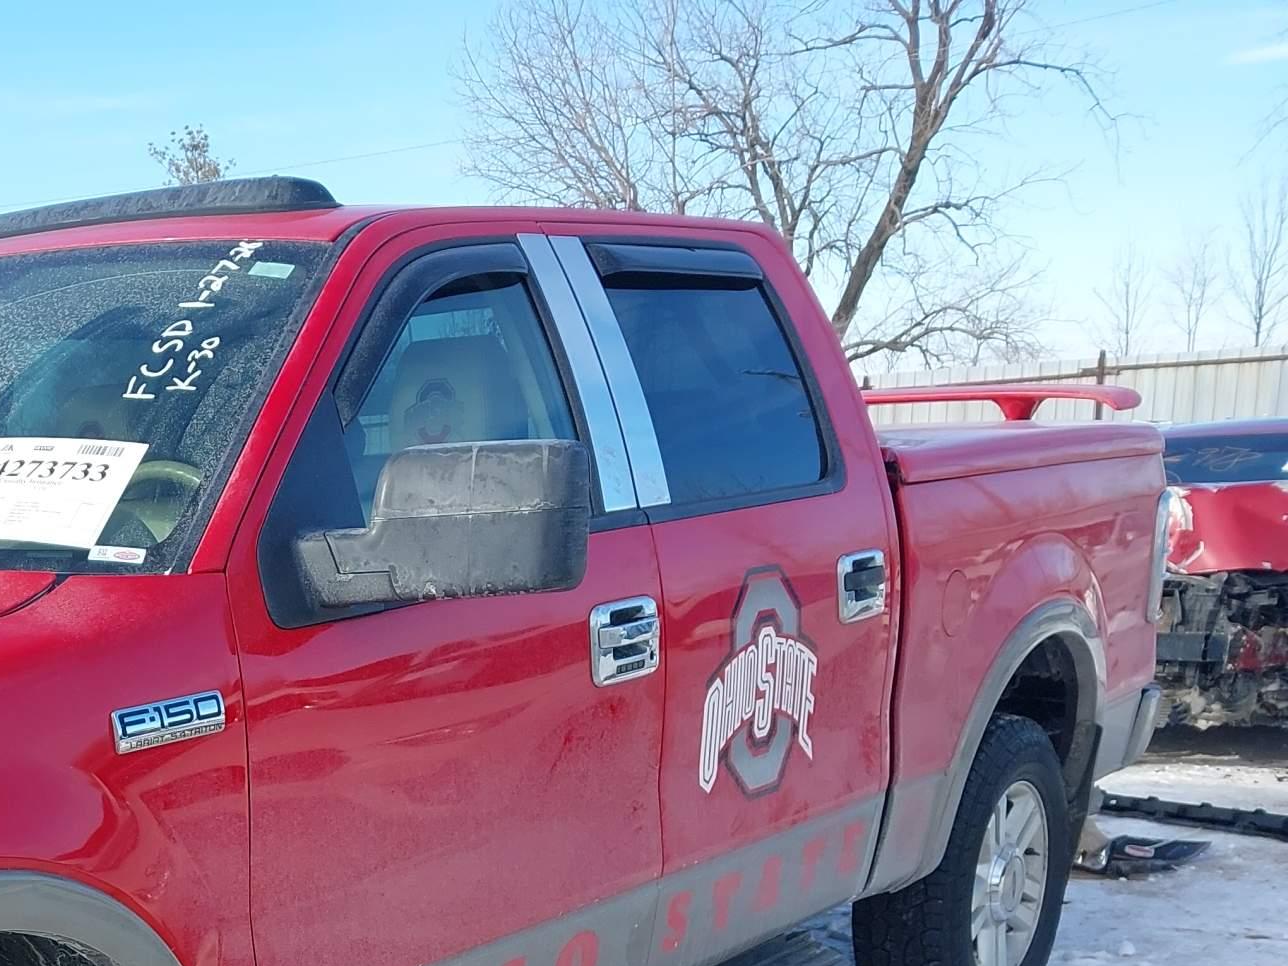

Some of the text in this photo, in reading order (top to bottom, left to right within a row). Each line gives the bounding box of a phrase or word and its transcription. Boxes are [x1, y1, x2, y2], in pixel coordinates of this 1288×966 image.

[166, 336, 220, 391] K-30
[117, 693, 223, 739] F-150
[699, 626, 818, 794] OHIO STATE
[661, 820, 866, 954] STATE
